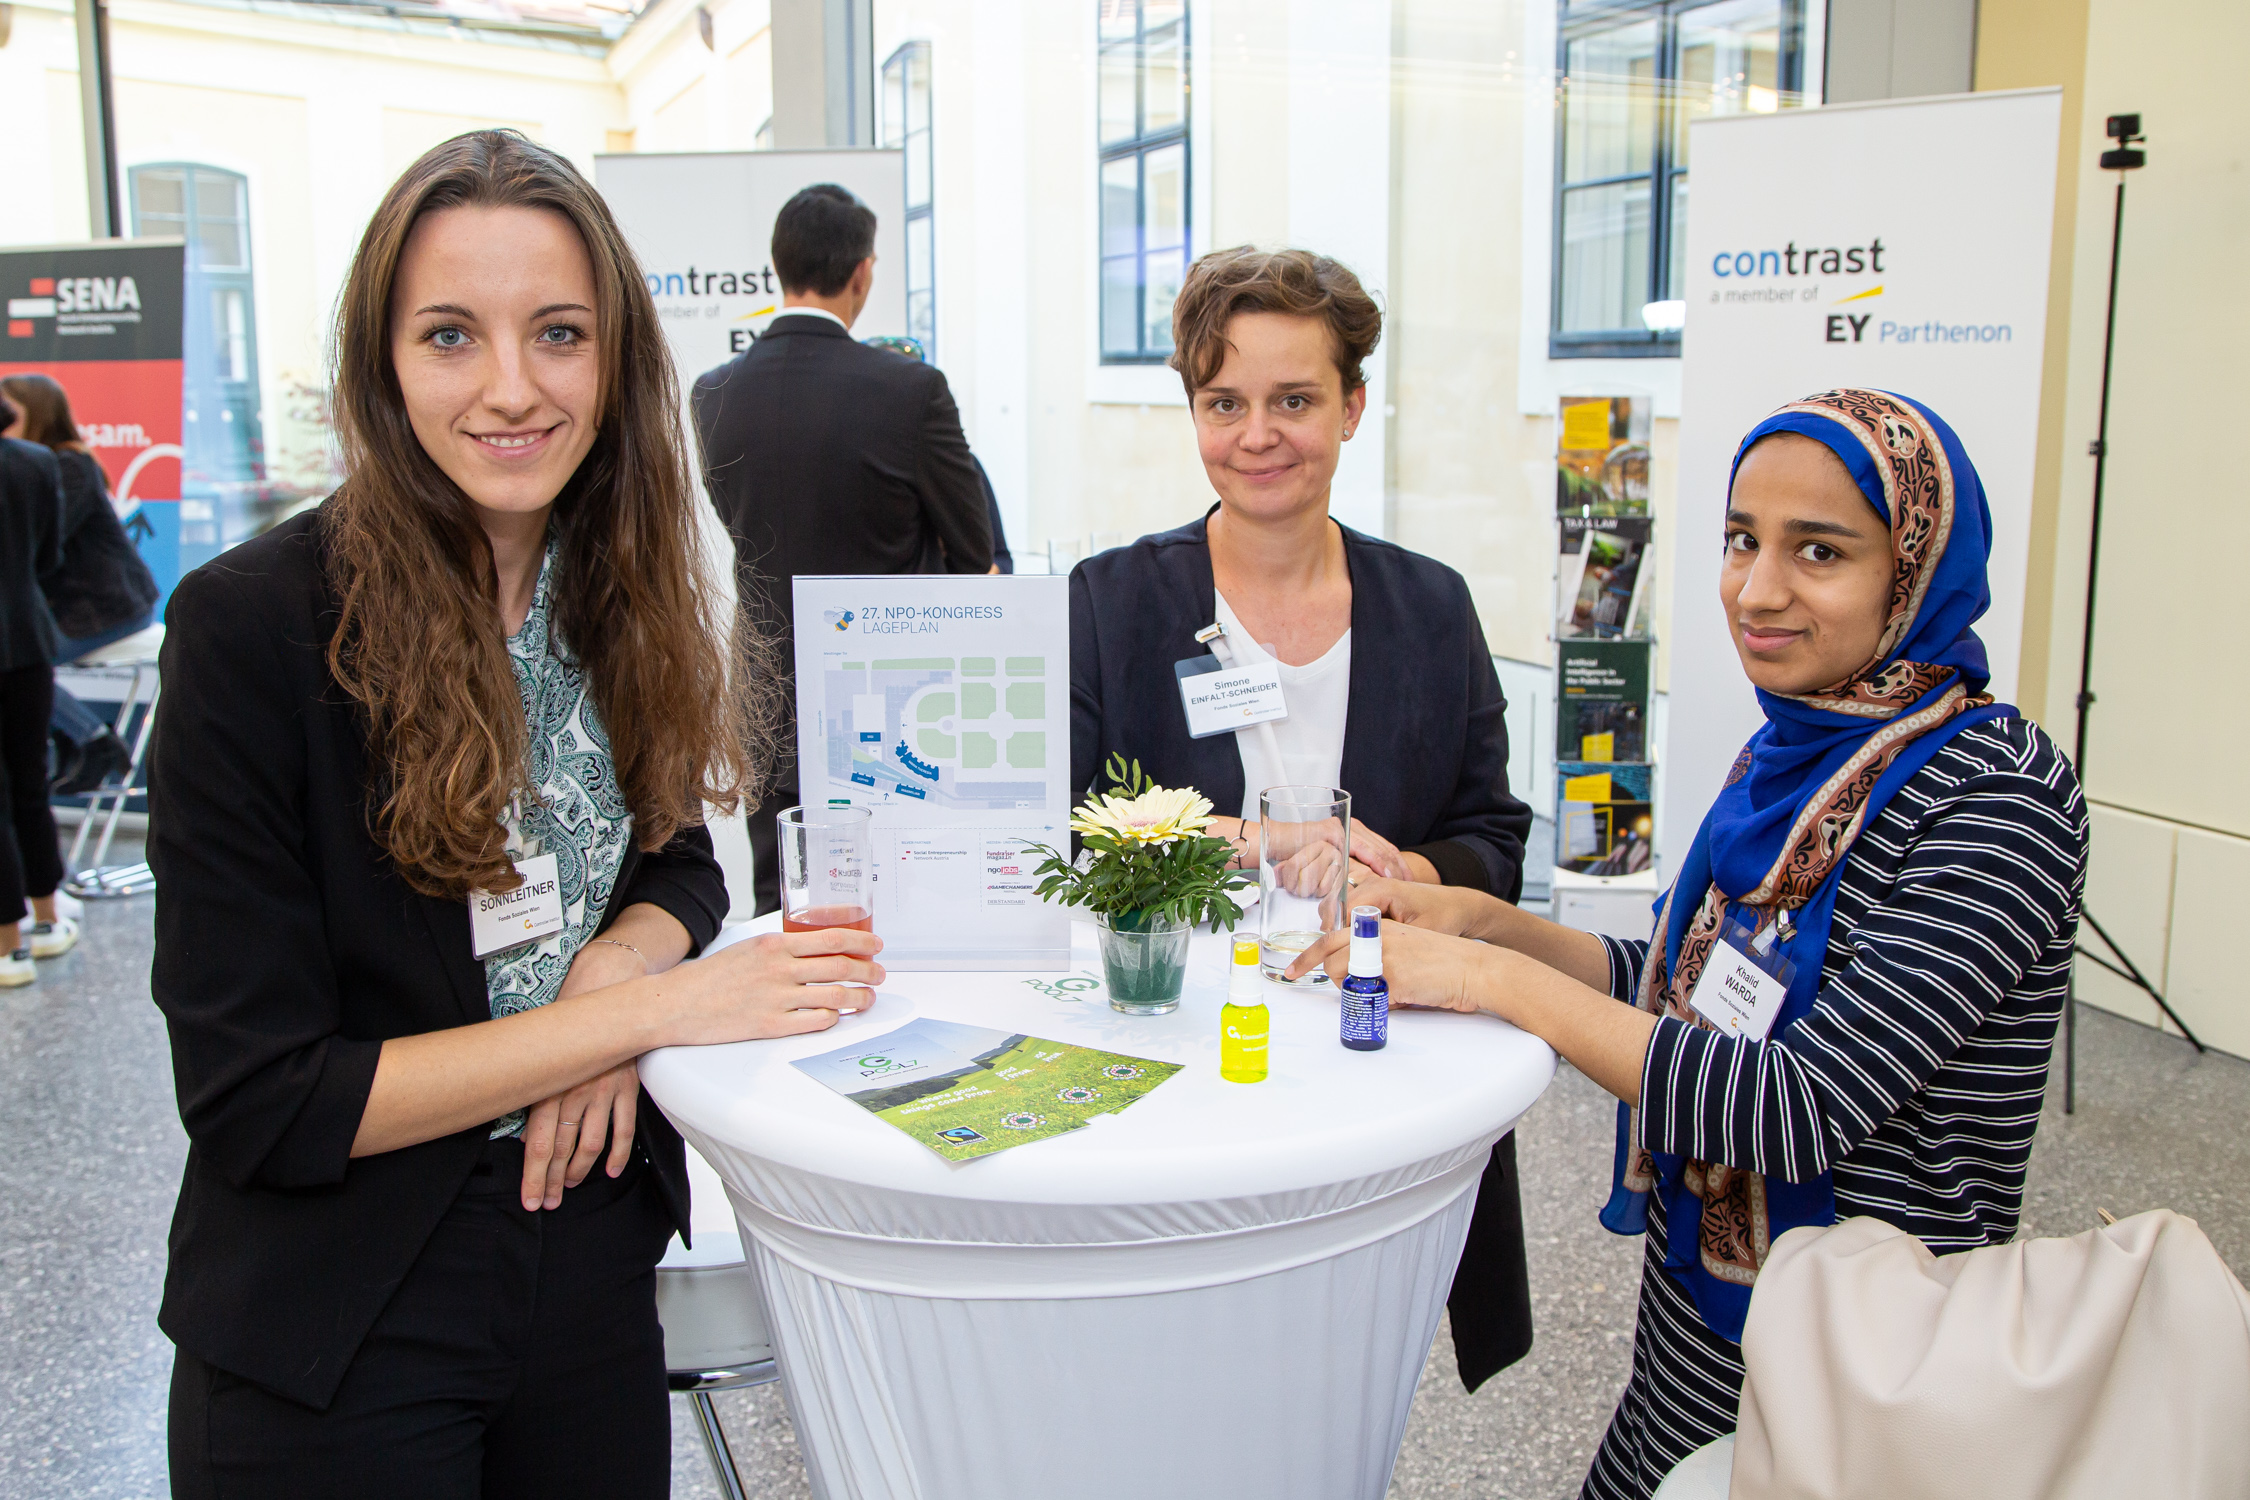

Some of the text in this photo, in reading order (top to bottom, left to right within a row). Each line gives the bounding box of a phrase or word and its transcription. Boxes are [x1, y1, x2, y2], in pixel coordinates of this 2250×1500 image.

[1713, 238, 1885, 277] contrast
[647, 266, 775, 296] ontrast
[57, 276, 141, 312] SENA
[1711, 285, 1819, 302] a member of
[1826, 313, 2012, 343] EY Parthenon
[862, 606, 1003, 619] 27. NPO-KONGRESS
[863, 622, 939, 634] LAGEPLAN
[1191, 682, 1278, 705] EINFALT-SCHNEIDER
[1214, 678, 1250, 690] Simone
[480, 880, 555, 912] SONNLEITNER
[498, 914, 511, 922] Fonds
[511, 909, 529, 918] Soziales
[1735, 965, 1760, 988] Khalid
[1724, 974, 1757, 1007] WARDA
